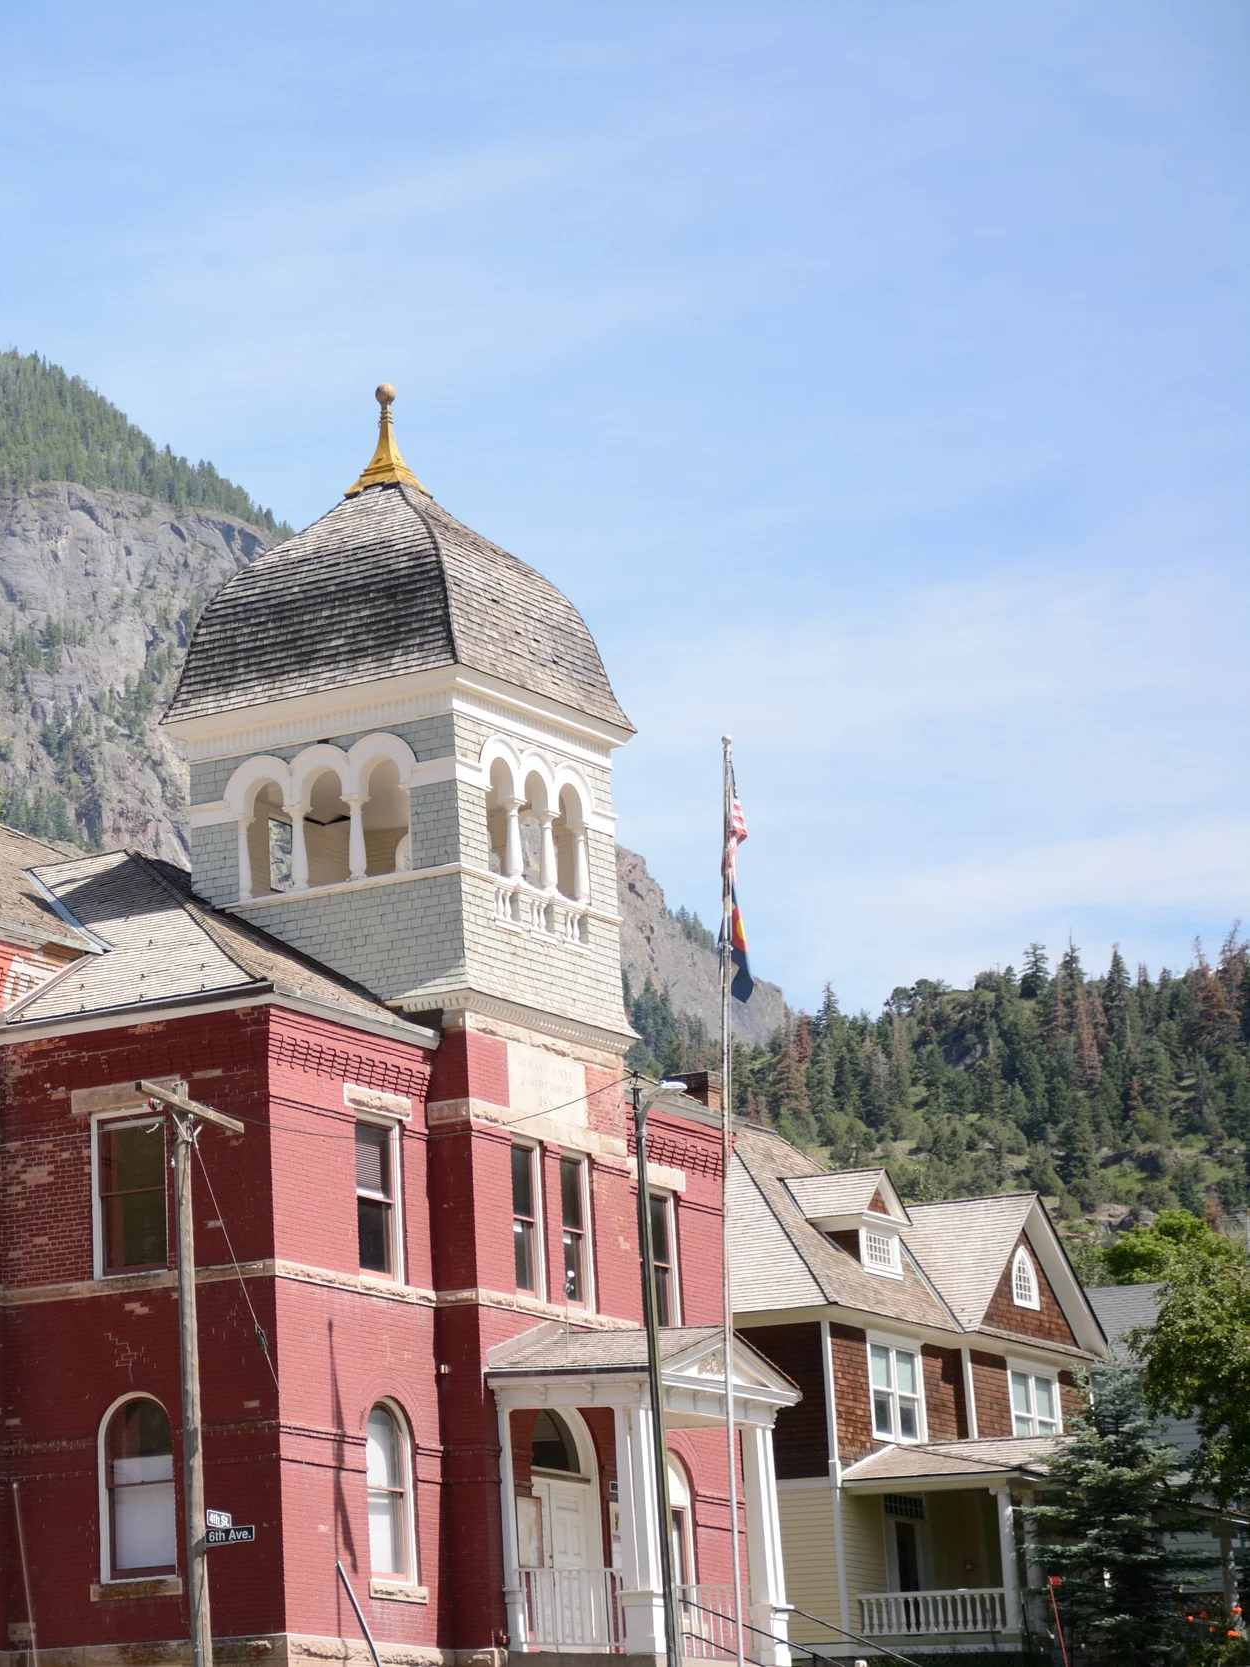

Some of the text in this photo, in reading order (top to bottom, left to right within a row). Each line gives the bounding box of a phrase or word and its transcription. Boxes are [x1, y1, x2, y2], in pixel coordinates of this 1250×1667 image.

[209, 1513, 230, 1527] 4th St.
[208, 1529, 252, 1542] 6th Ave.
